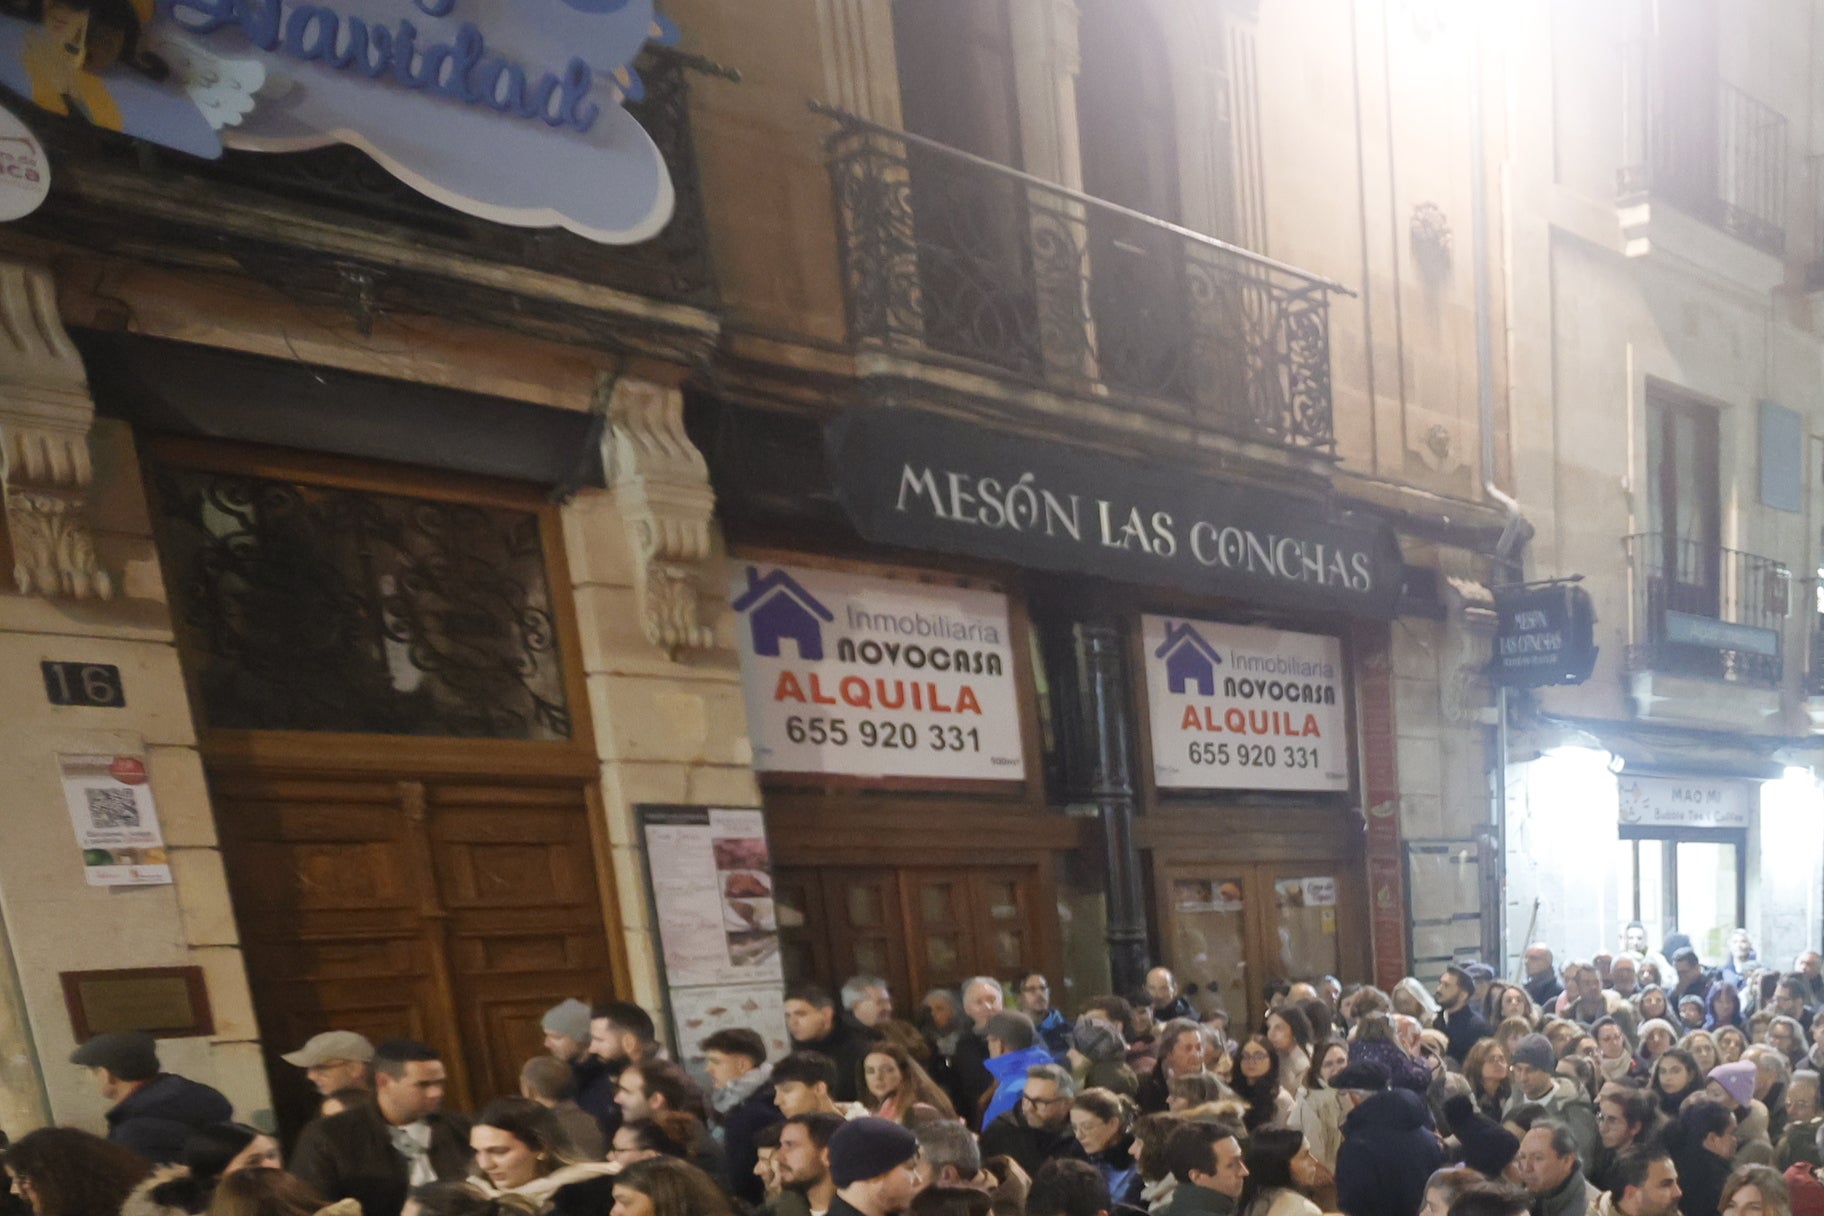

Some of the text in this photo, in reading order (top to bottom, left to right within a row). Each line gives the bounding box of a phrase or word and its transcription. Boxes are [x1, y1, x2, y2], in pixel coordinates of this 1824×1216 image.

[895, 463, 1372, 591] MESÓN LAS CONCHAS
[847, 605, 1000, 644] Inmobiliaria
[837, 636, 1002, 676] NOVOCASA
[1230, 650, 1335, 679] Inmobiliaria
[52, 664, 115, 702] 16
[774, 669, 983, 716] ALQUILA
[1224, 676, 1335, 705] NOVOCASA
[786, 715, 980, 753] 655 920 331
[1181, 704, 1321, 738] ALQUILA
[1188, 741, 1319, 769] 655 920 331
[1671, 788, 1702, 803] MAO
